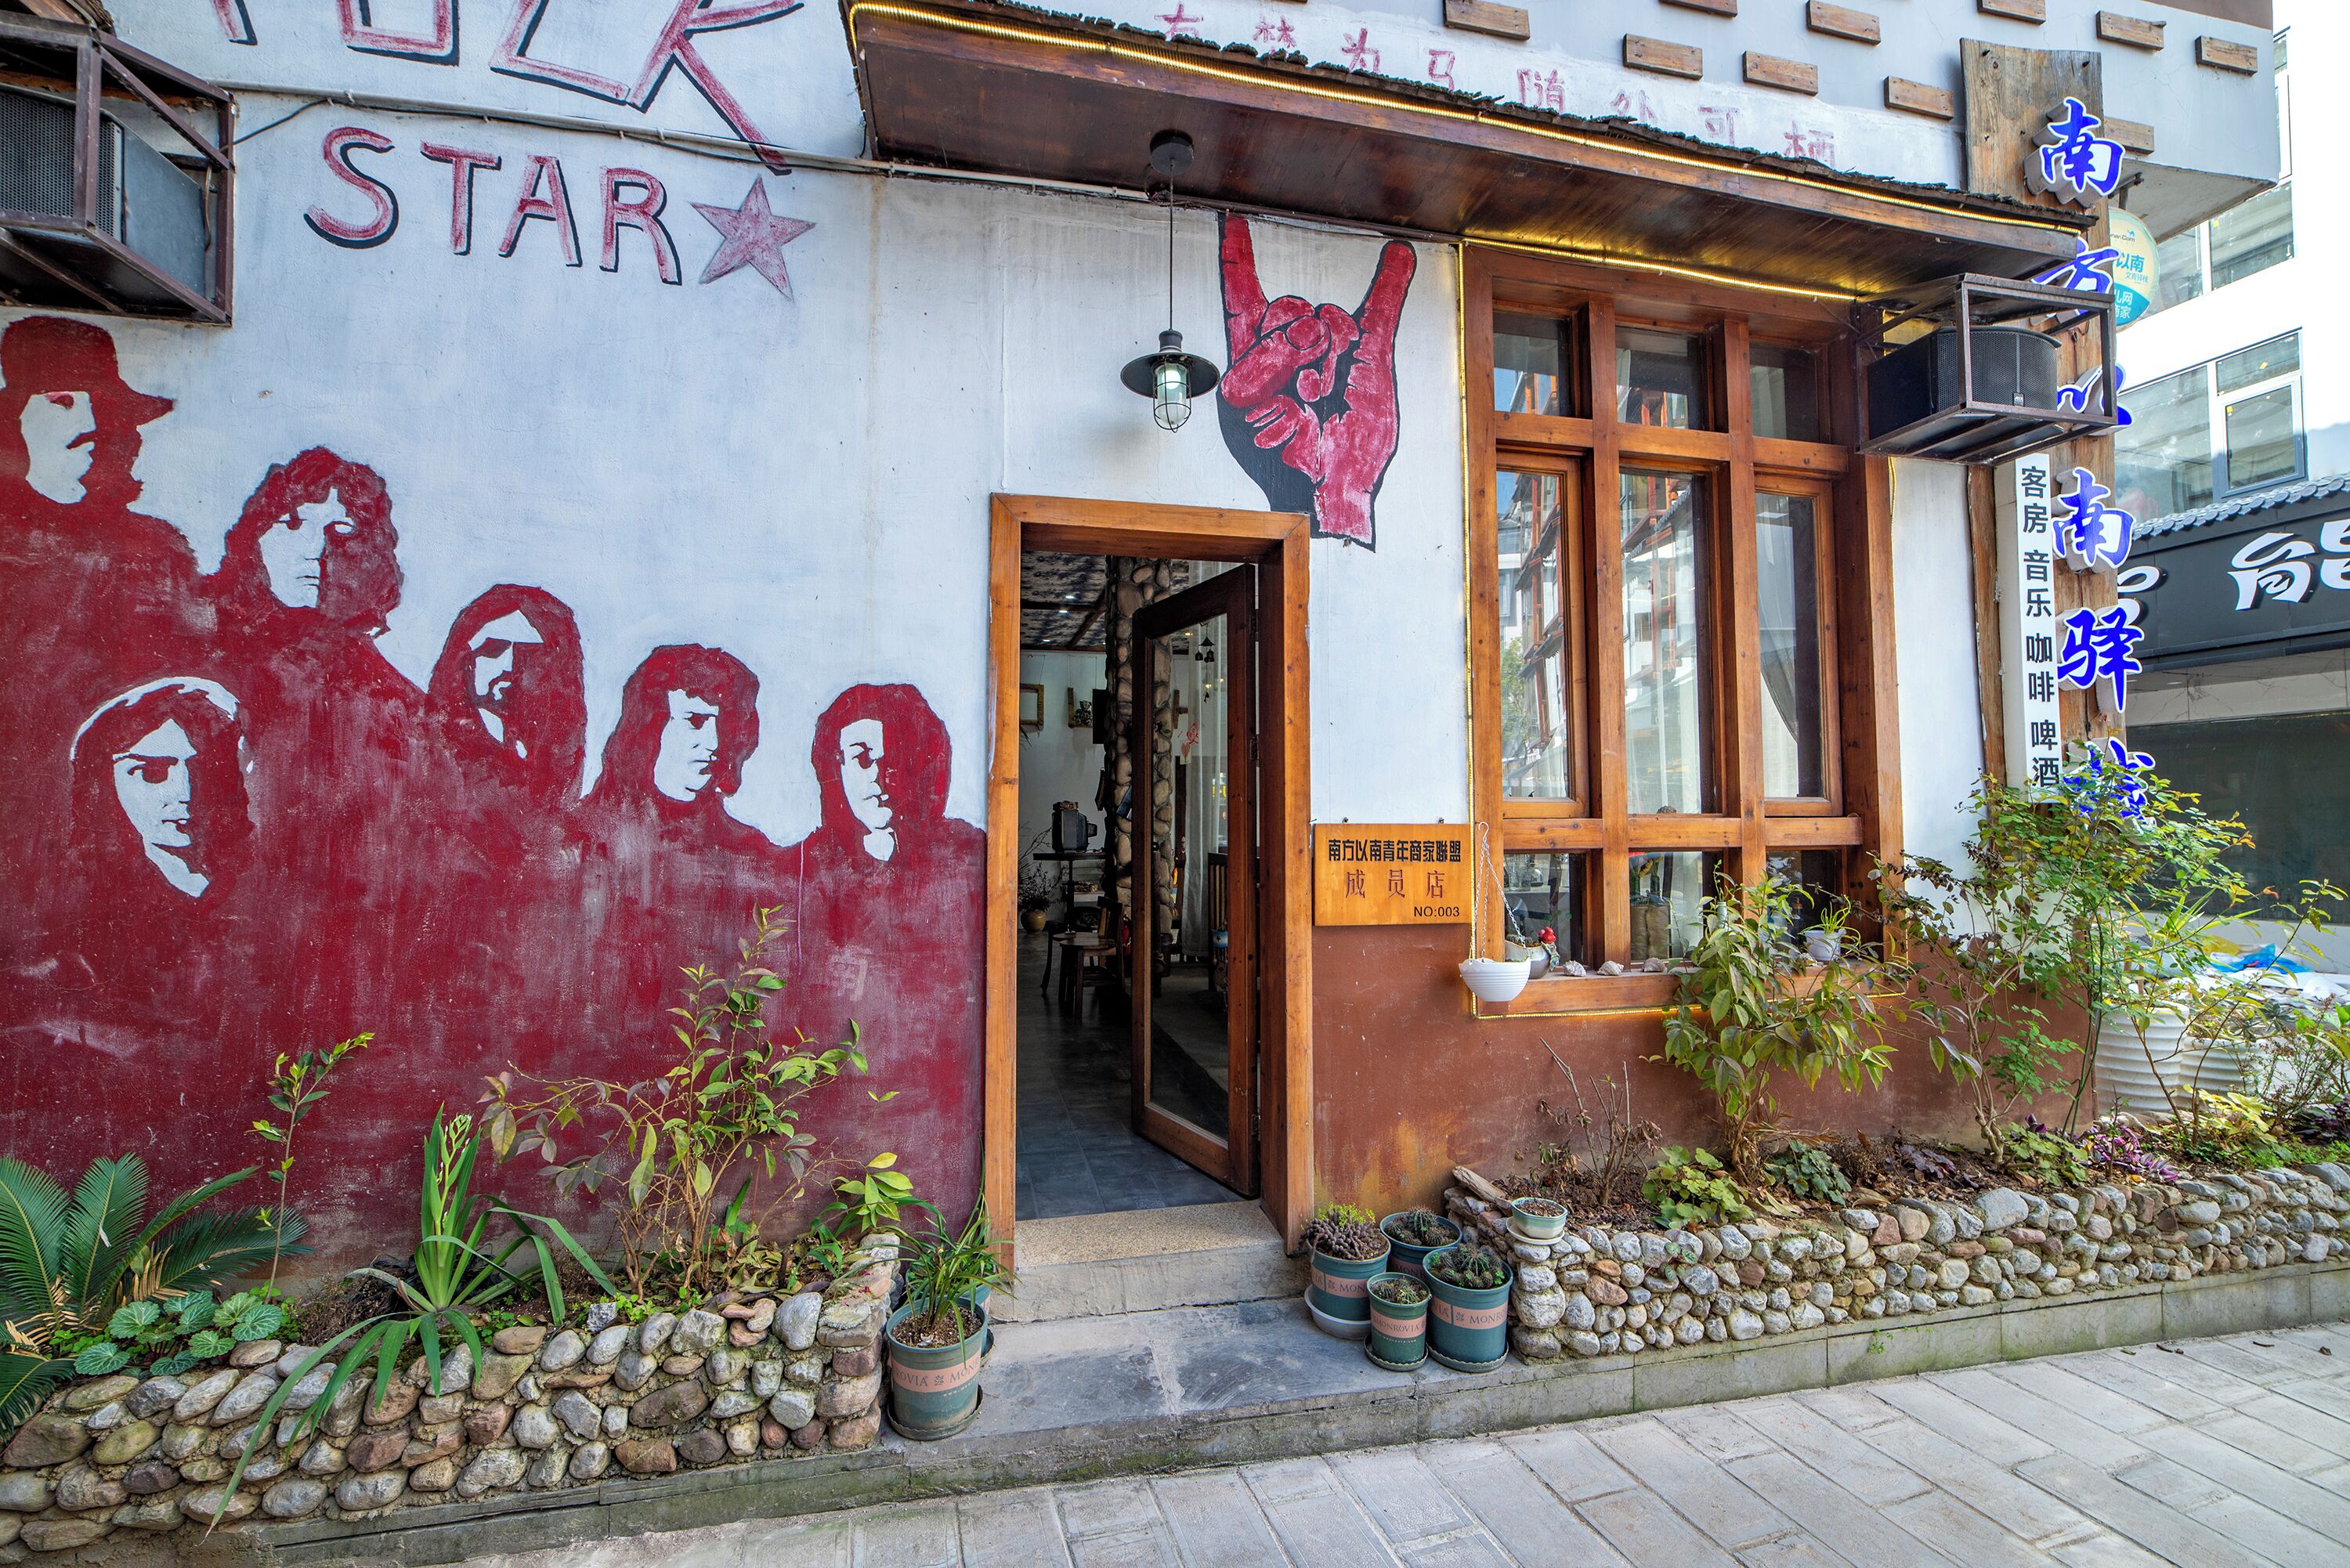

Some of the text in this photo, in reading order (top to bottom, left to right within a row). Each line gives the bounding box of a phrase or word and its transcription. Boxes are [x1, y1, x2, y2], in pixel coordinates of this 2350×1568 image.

[304, 126, 682, 286] STAR
[2020, 465, 2059, 788] 客房 音乐 咖啡 啤酒
[1414, 906, 1460, 918] NO:003
